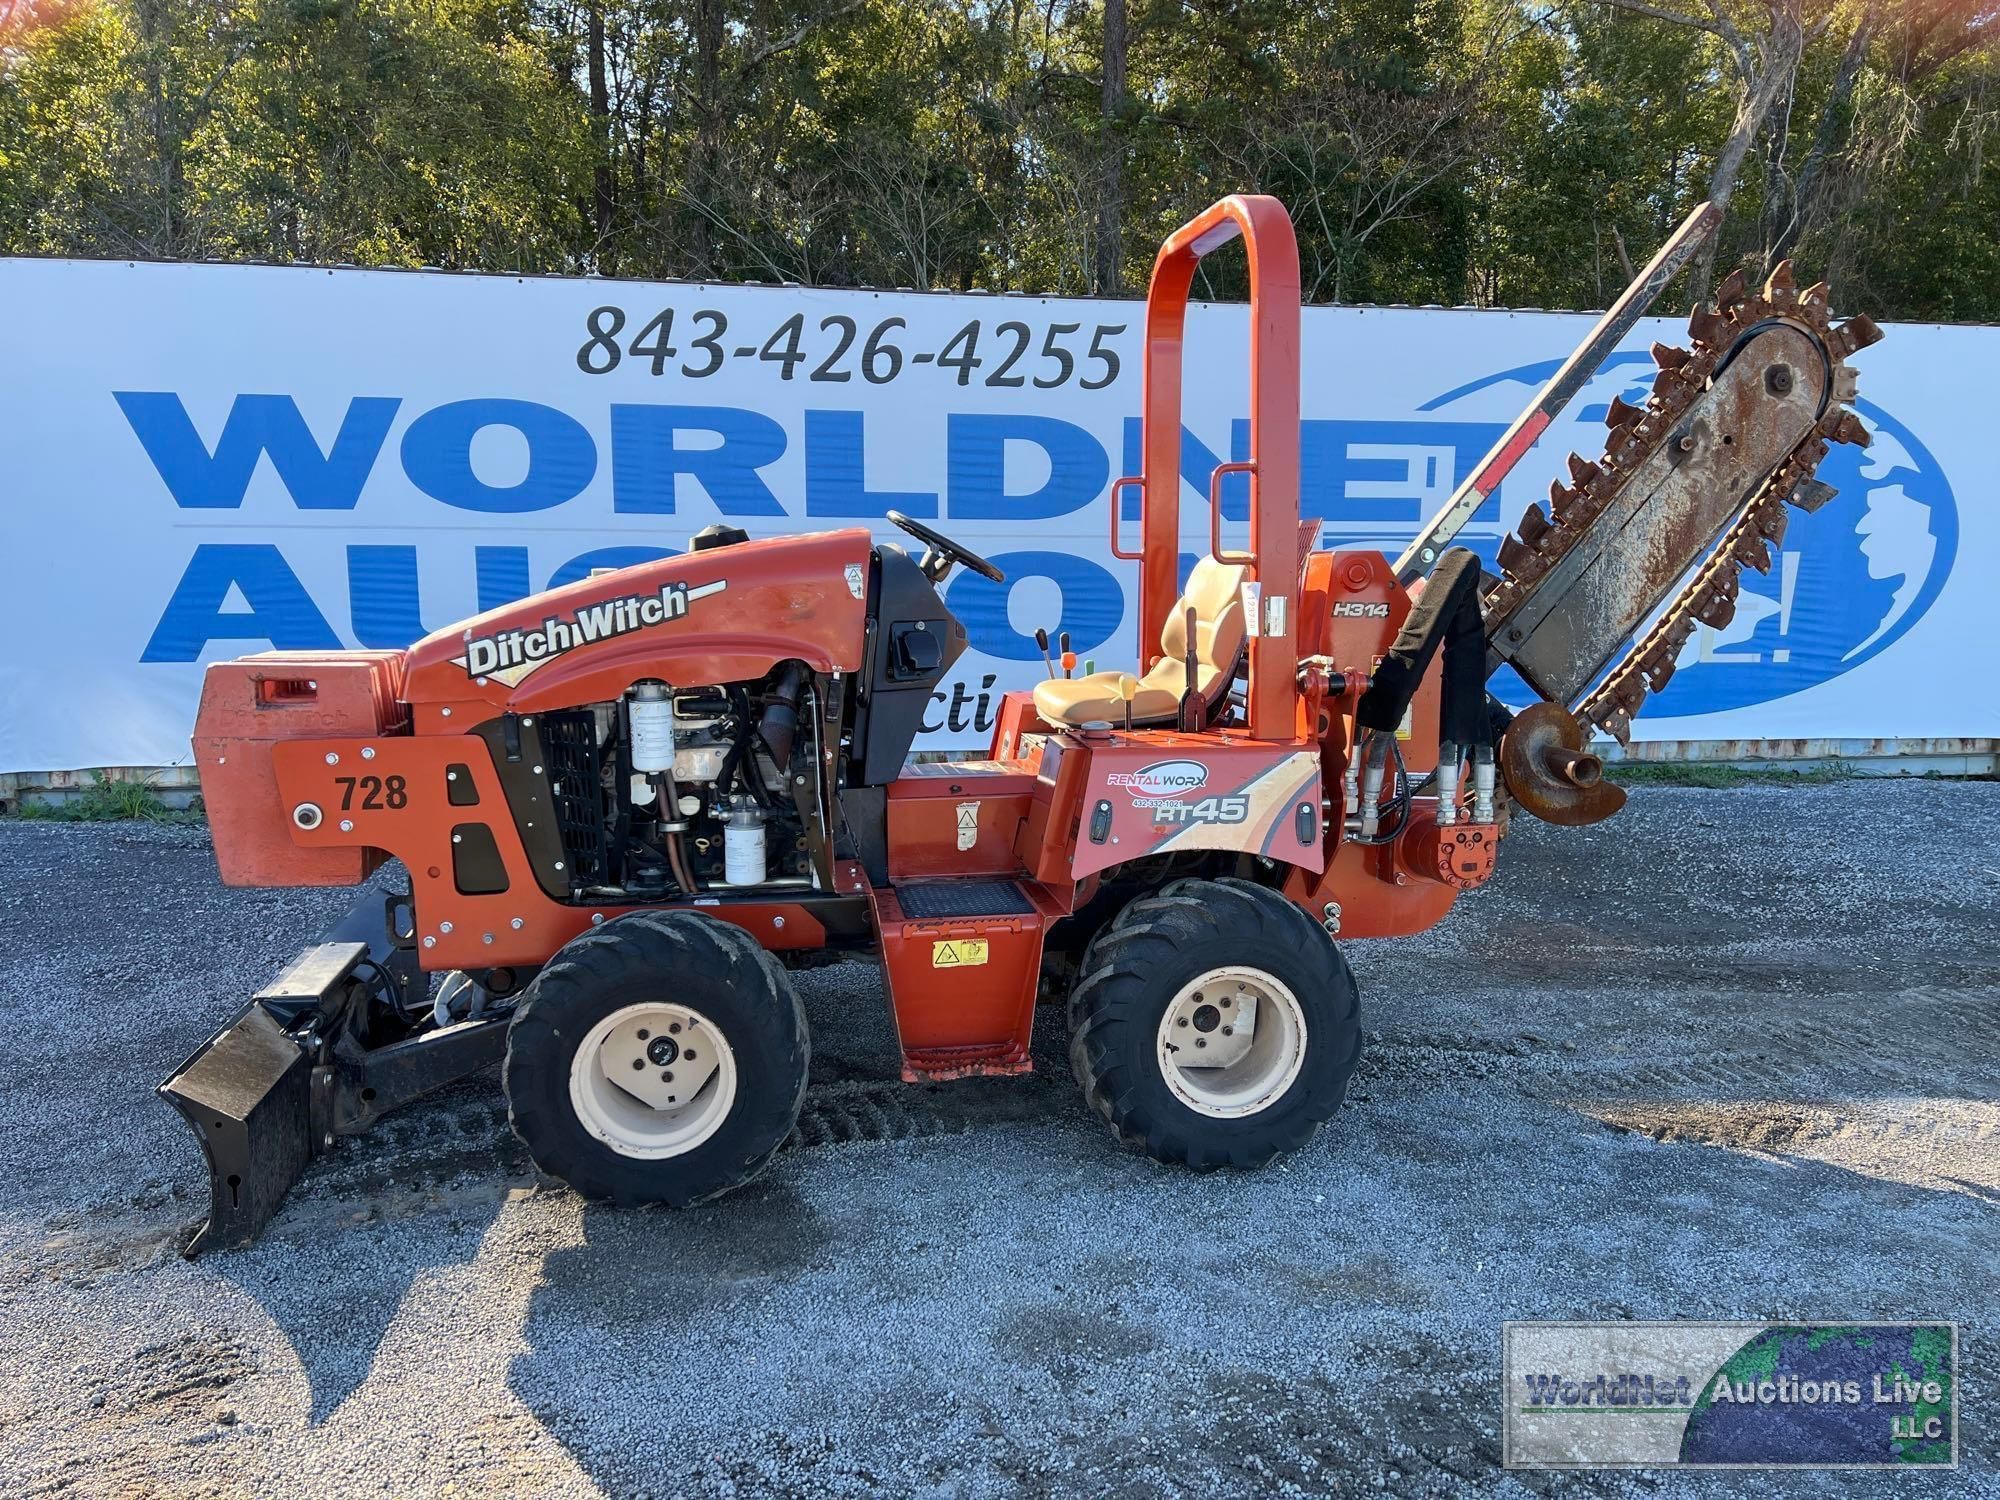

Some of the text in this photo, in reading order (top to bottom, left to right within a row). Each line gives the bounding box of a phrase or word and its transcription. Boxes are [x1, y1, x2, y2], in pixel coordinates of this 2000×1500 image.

[577, 305, 1127, 390] 843-426-4255
[1332, 602, 1389, 617] H314
[1107, 773, 1206, 787] RENTAL WORX
[335, 775, 408, 811] 728
[1133, 799, 1184, 808] 432-332-1021
[1154, 798, 1246, 822] RT45
